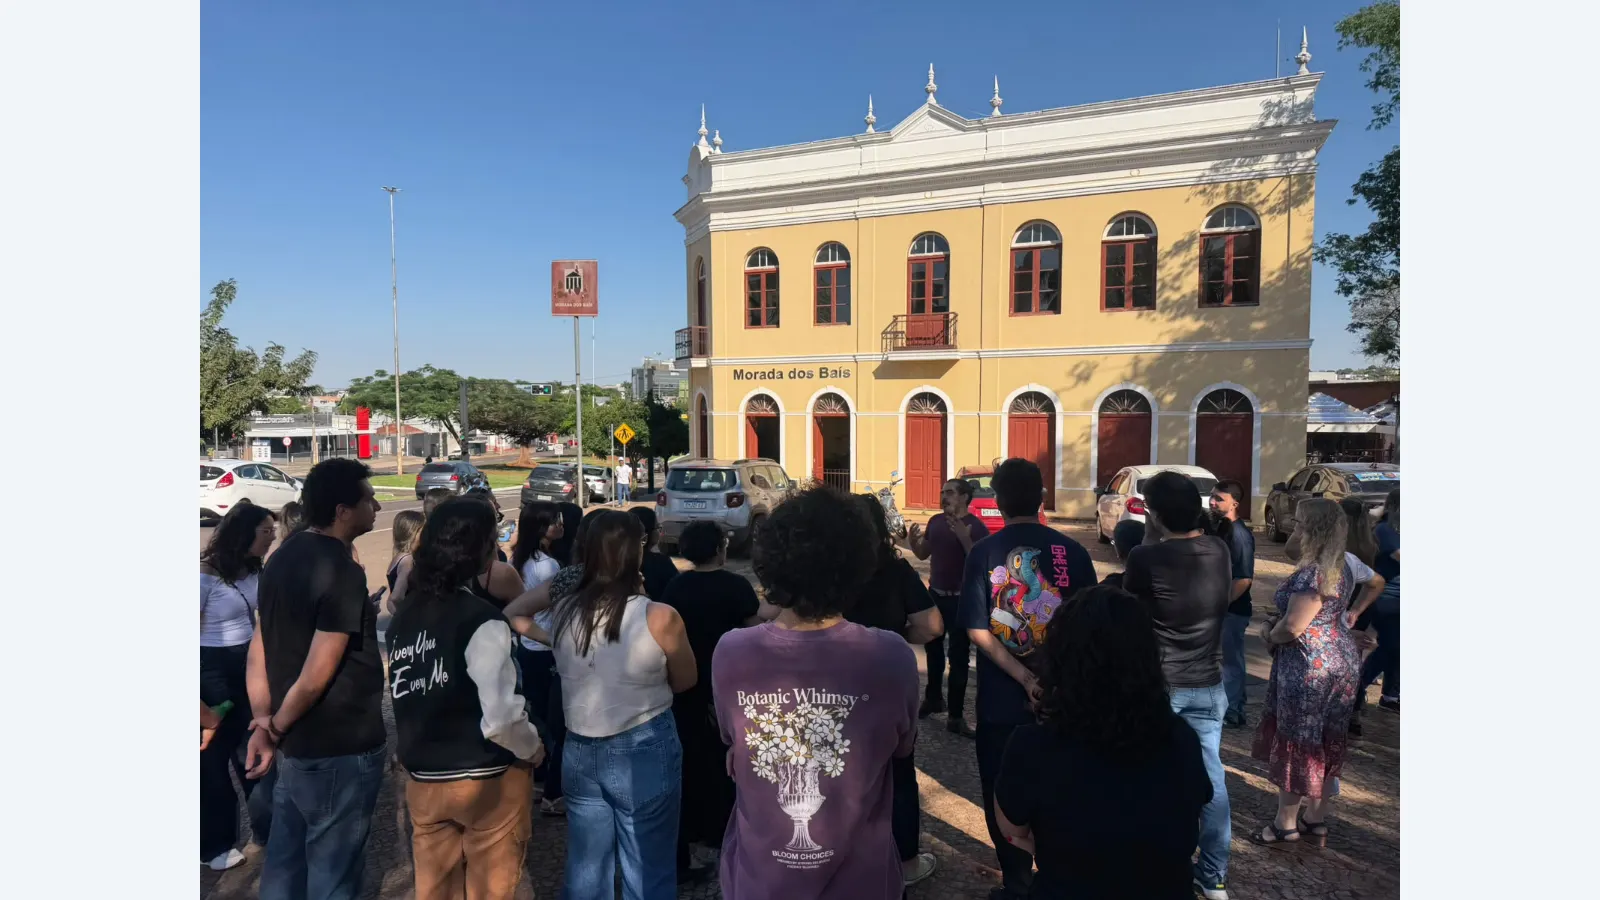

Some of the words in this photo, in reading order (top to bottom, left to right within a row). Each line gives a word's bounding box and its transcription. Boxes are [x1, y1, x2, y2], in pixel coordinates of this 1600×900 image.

[733, 368, 784, 380] Morada
[788, 367, 814, 380] dos
[819, 366, 851, 379] Baís
[391, 665, 426, 699] Every
[428, 656, 449, 690] Me
[736, 688, 791, 706] Botanic
[792, 687, 859, 711] Whimsy
[771, 850, 799, 860] BLOOM
[800, 849, 834, 860] CHOICES
